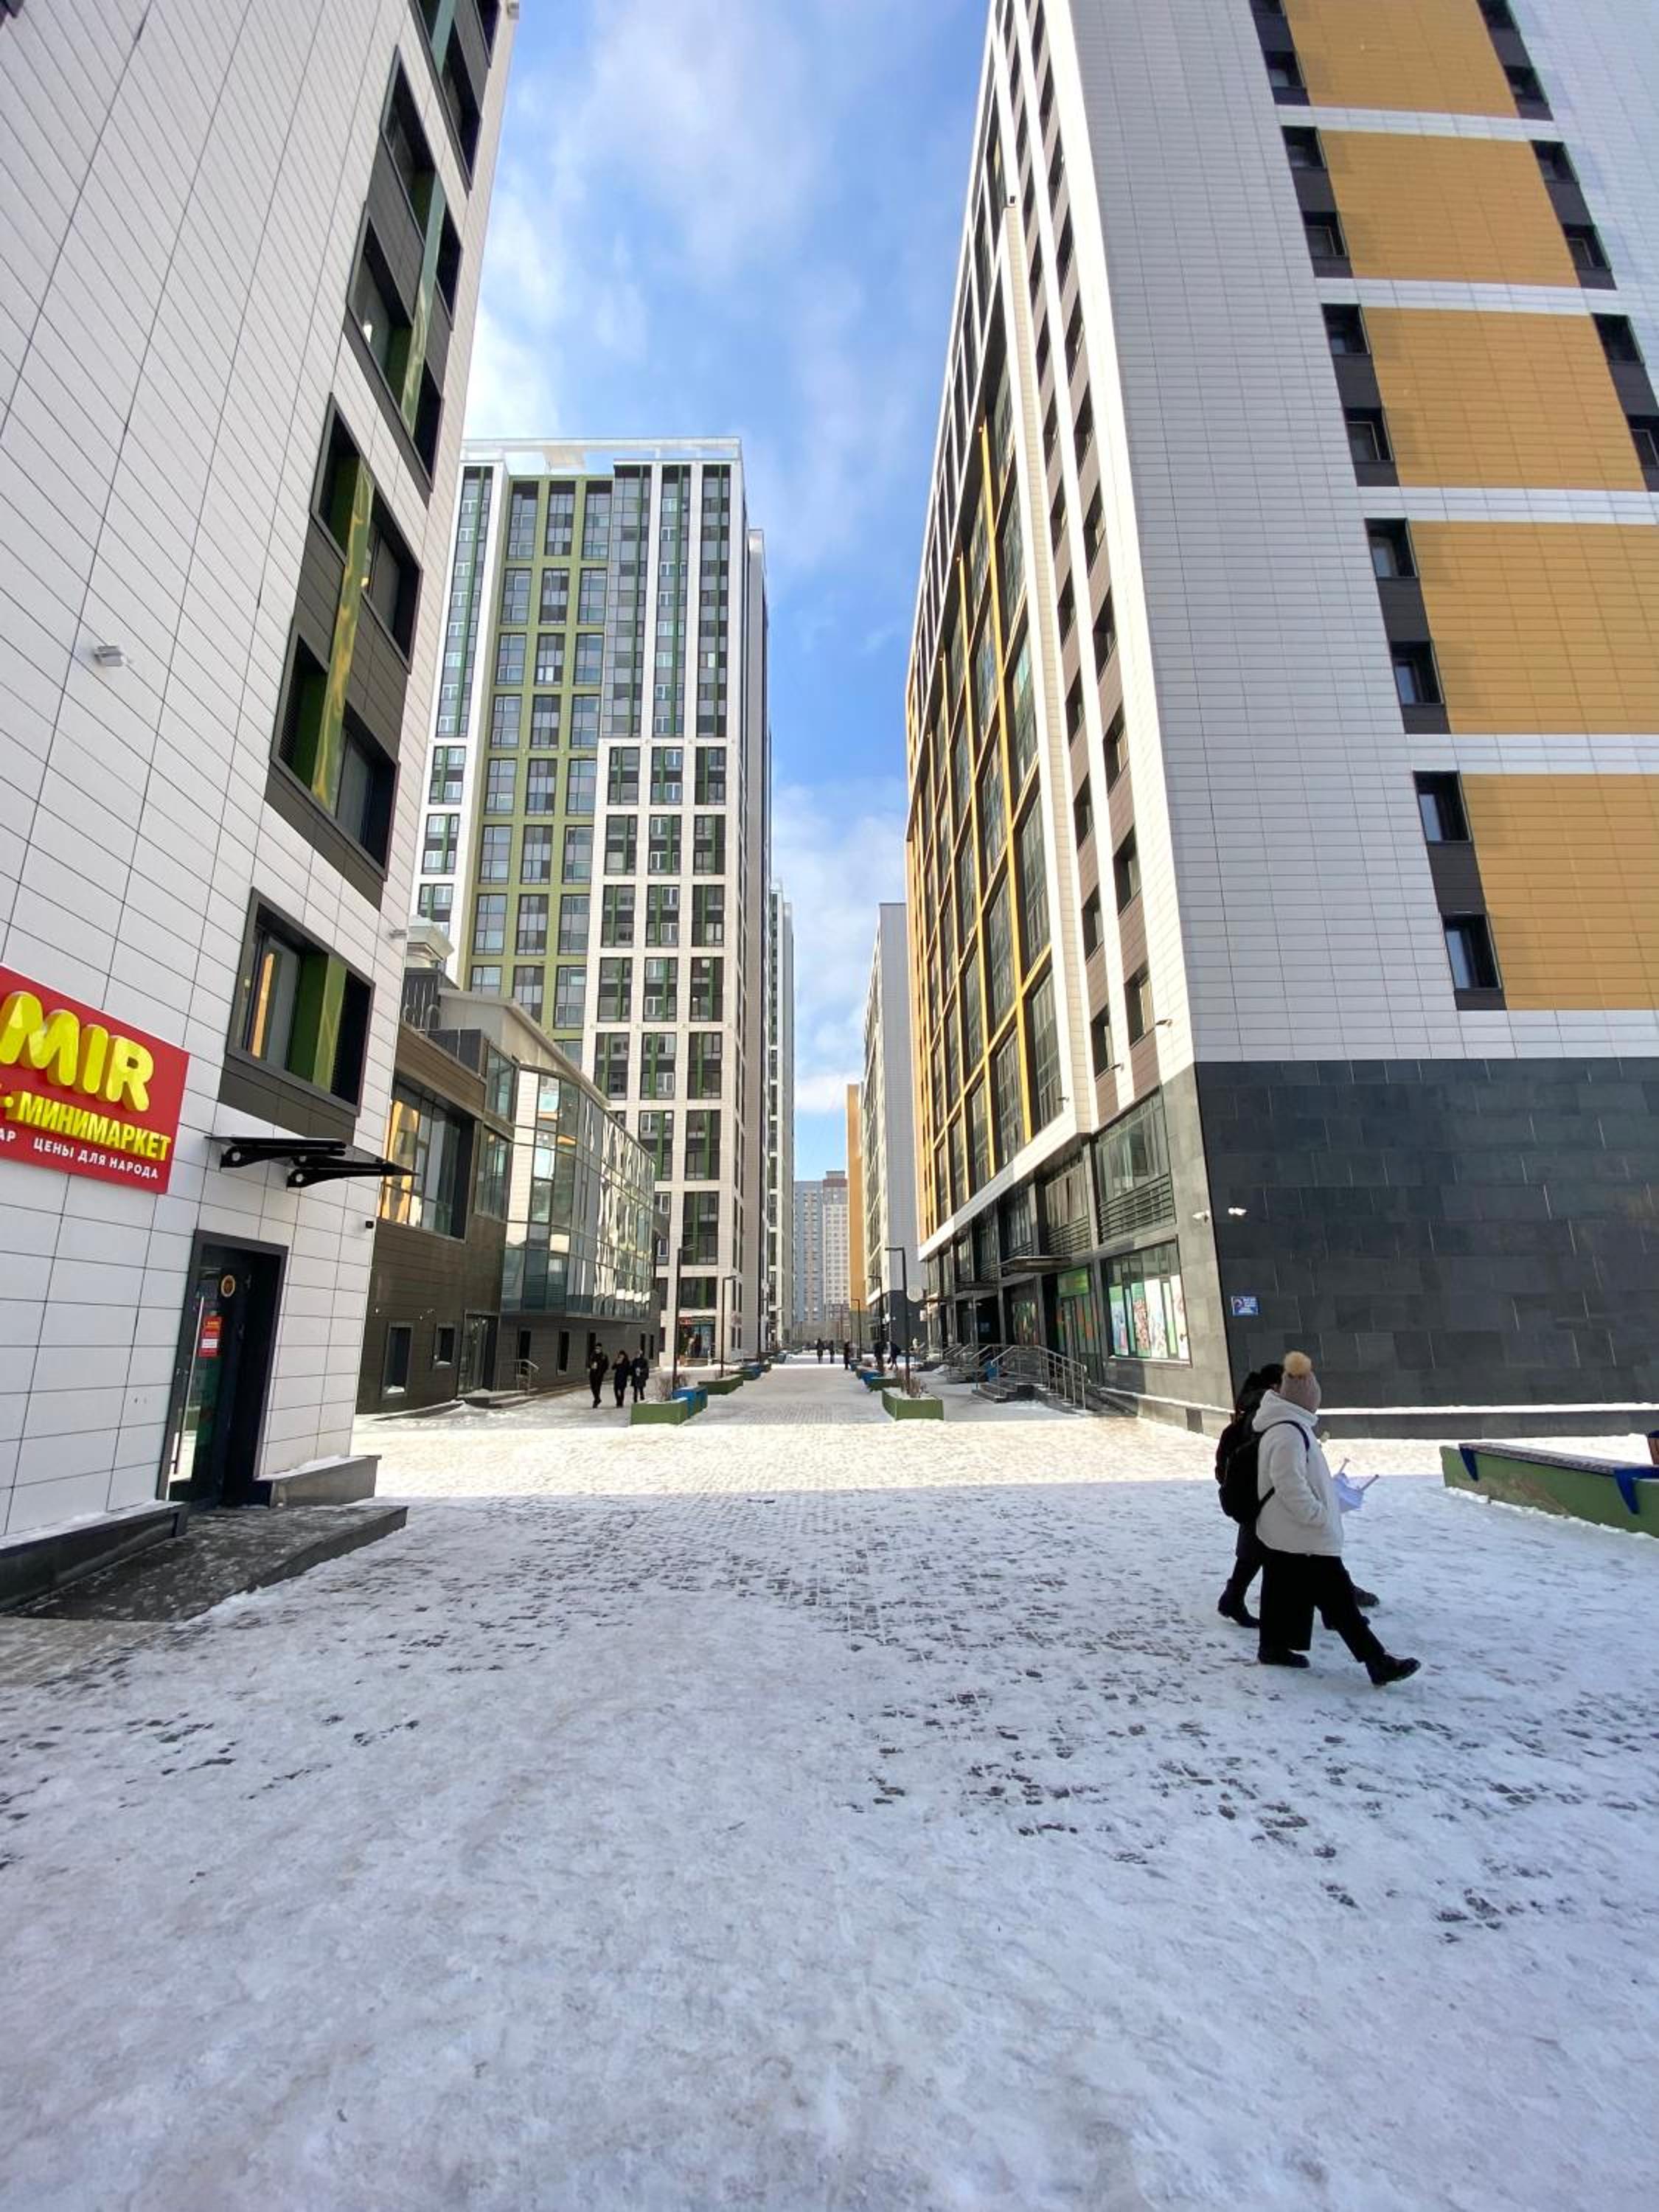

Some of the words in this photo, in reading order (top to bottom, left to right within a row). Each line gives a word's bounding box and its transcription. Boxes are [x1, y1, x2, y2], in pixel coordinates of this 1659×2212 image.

[17, 1091, 171, 1161] МИНИМАРКЕТ
[33, 1137, 74, 1158] ЦЕНЫ
[77, 1150, 106, 1166] ДЛЯ
[109, 1157, 159, 1180] НАРОДА
